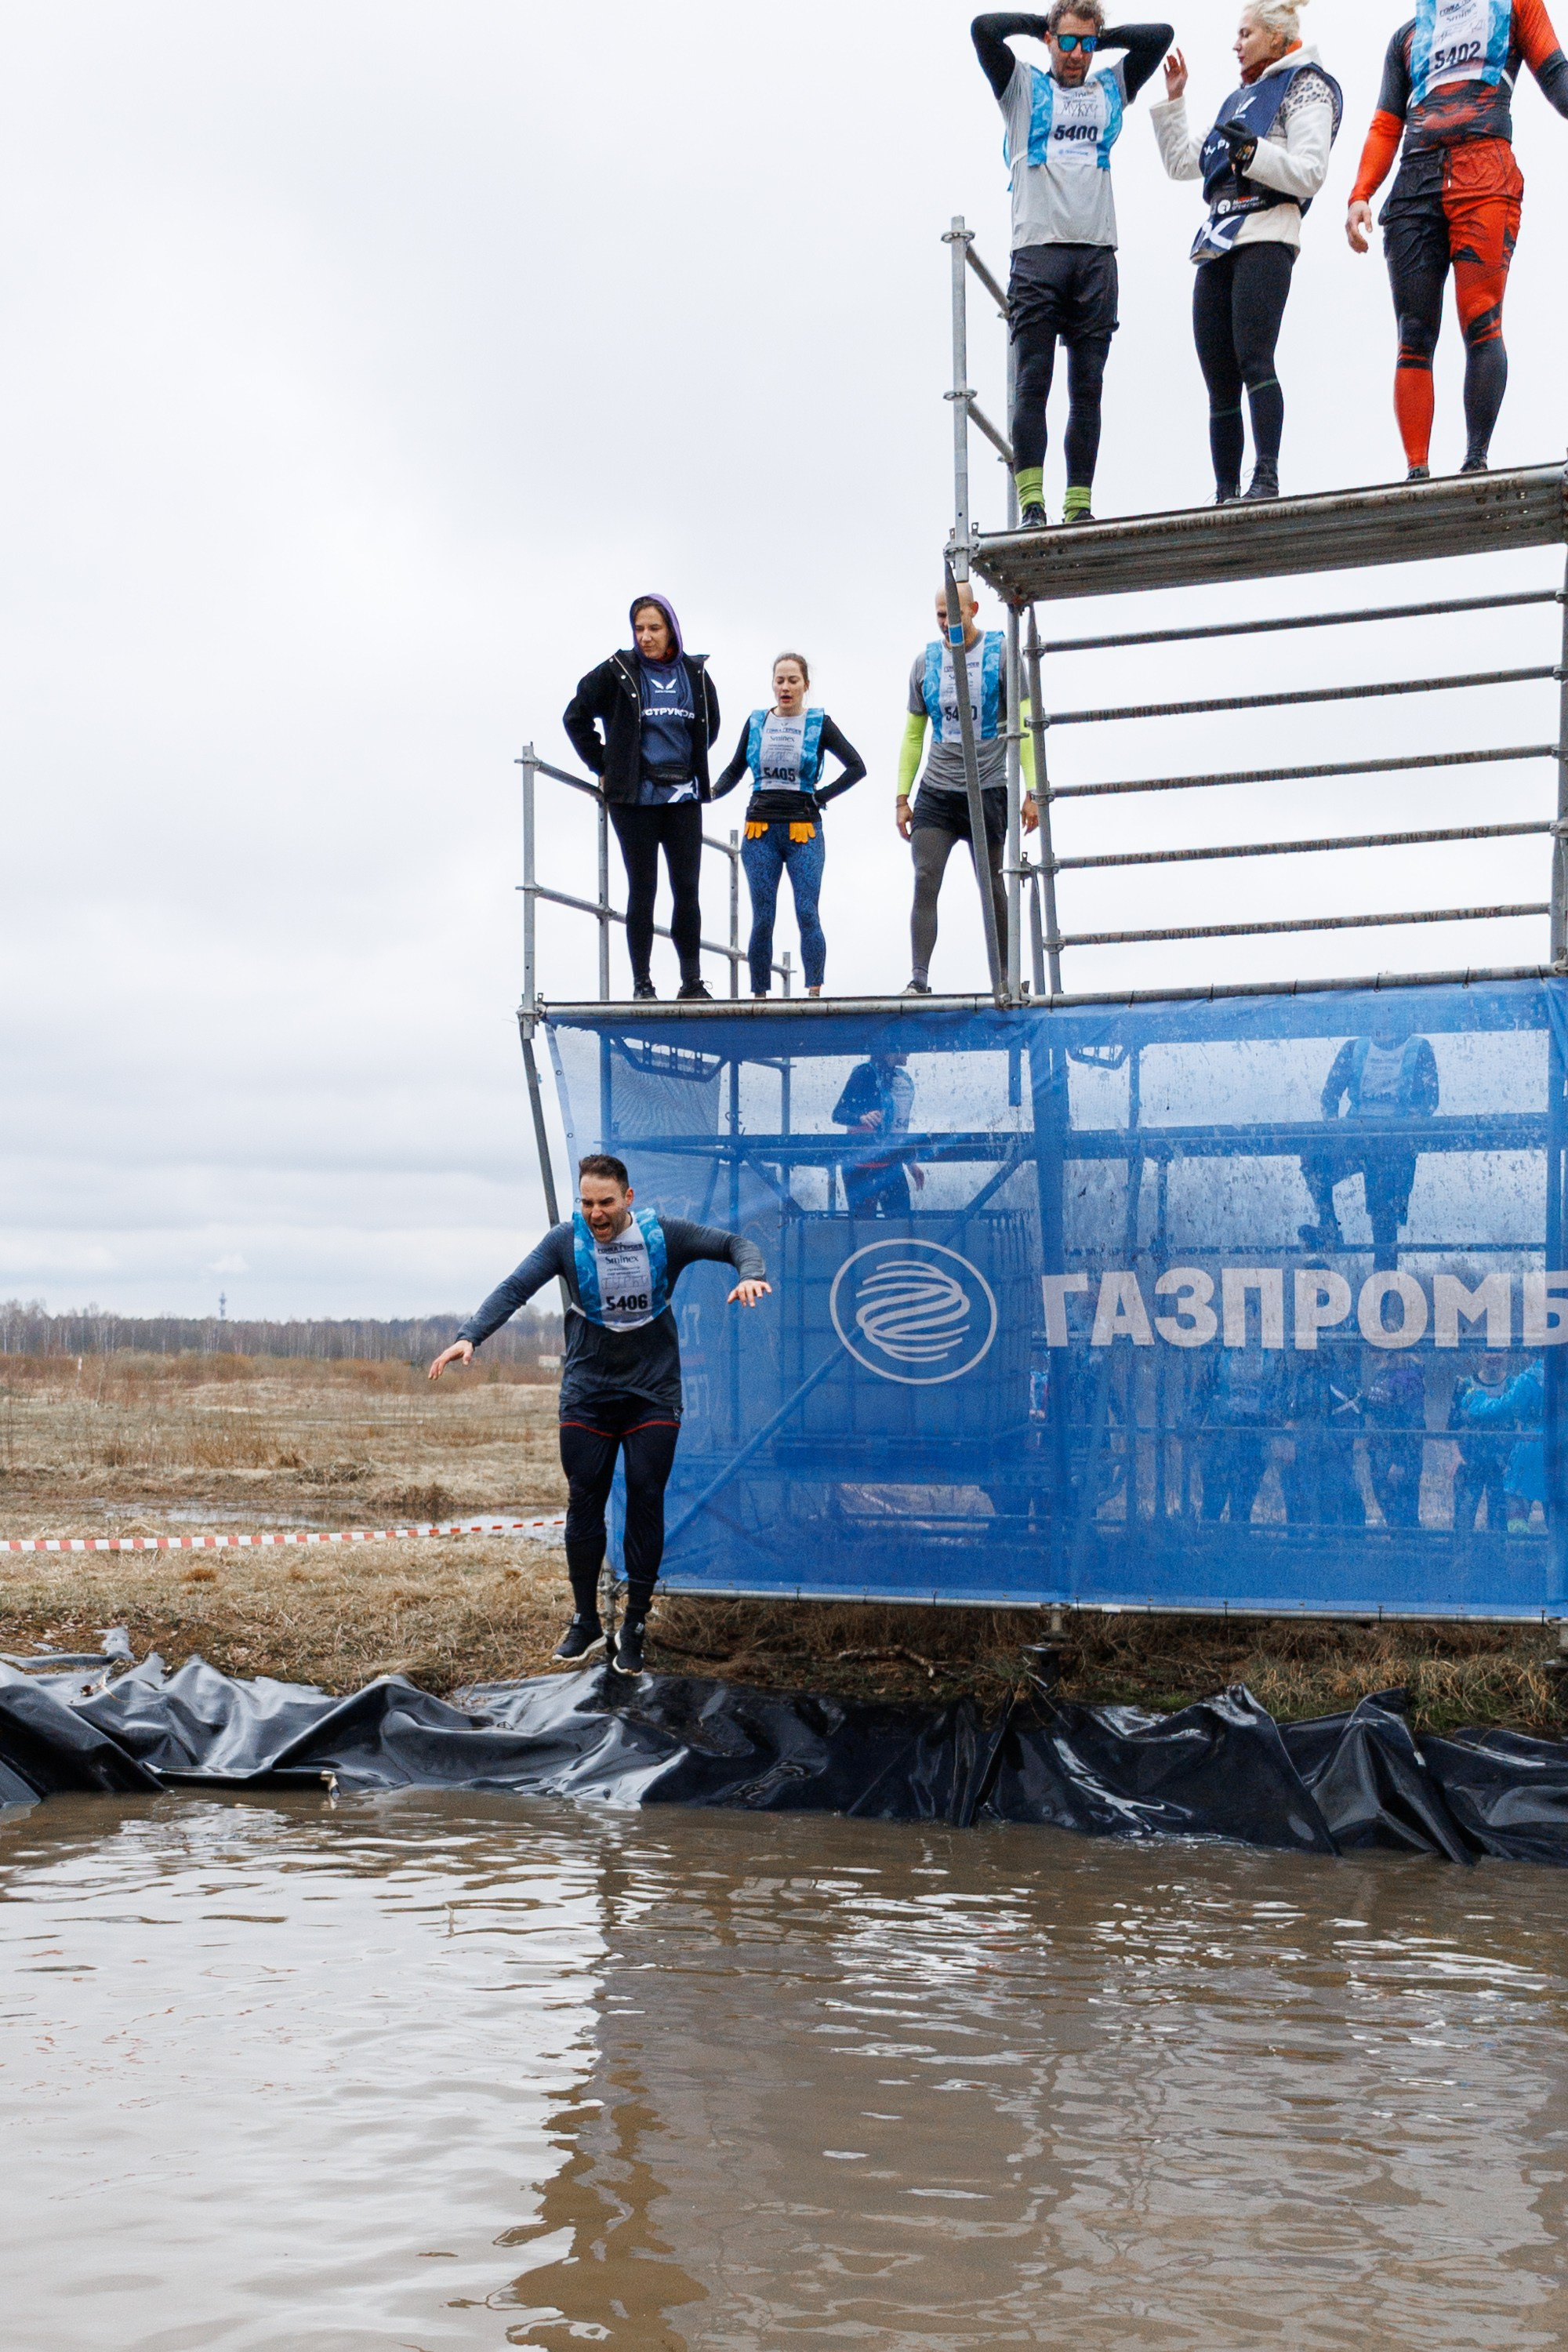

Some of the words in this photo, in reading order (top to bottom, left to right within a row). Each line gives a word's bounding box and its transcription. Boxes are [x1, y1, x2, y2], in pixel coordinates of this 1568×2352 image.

[1435, 40, 1481, 69] 5402
[1054, 124, 1099, 143] 5400
[763, 766, 797, 783] 5405
[605, 1293, 649, 1312] 5406
[1042, 1267, 1568, 1349] ГАЗПРОМБ
